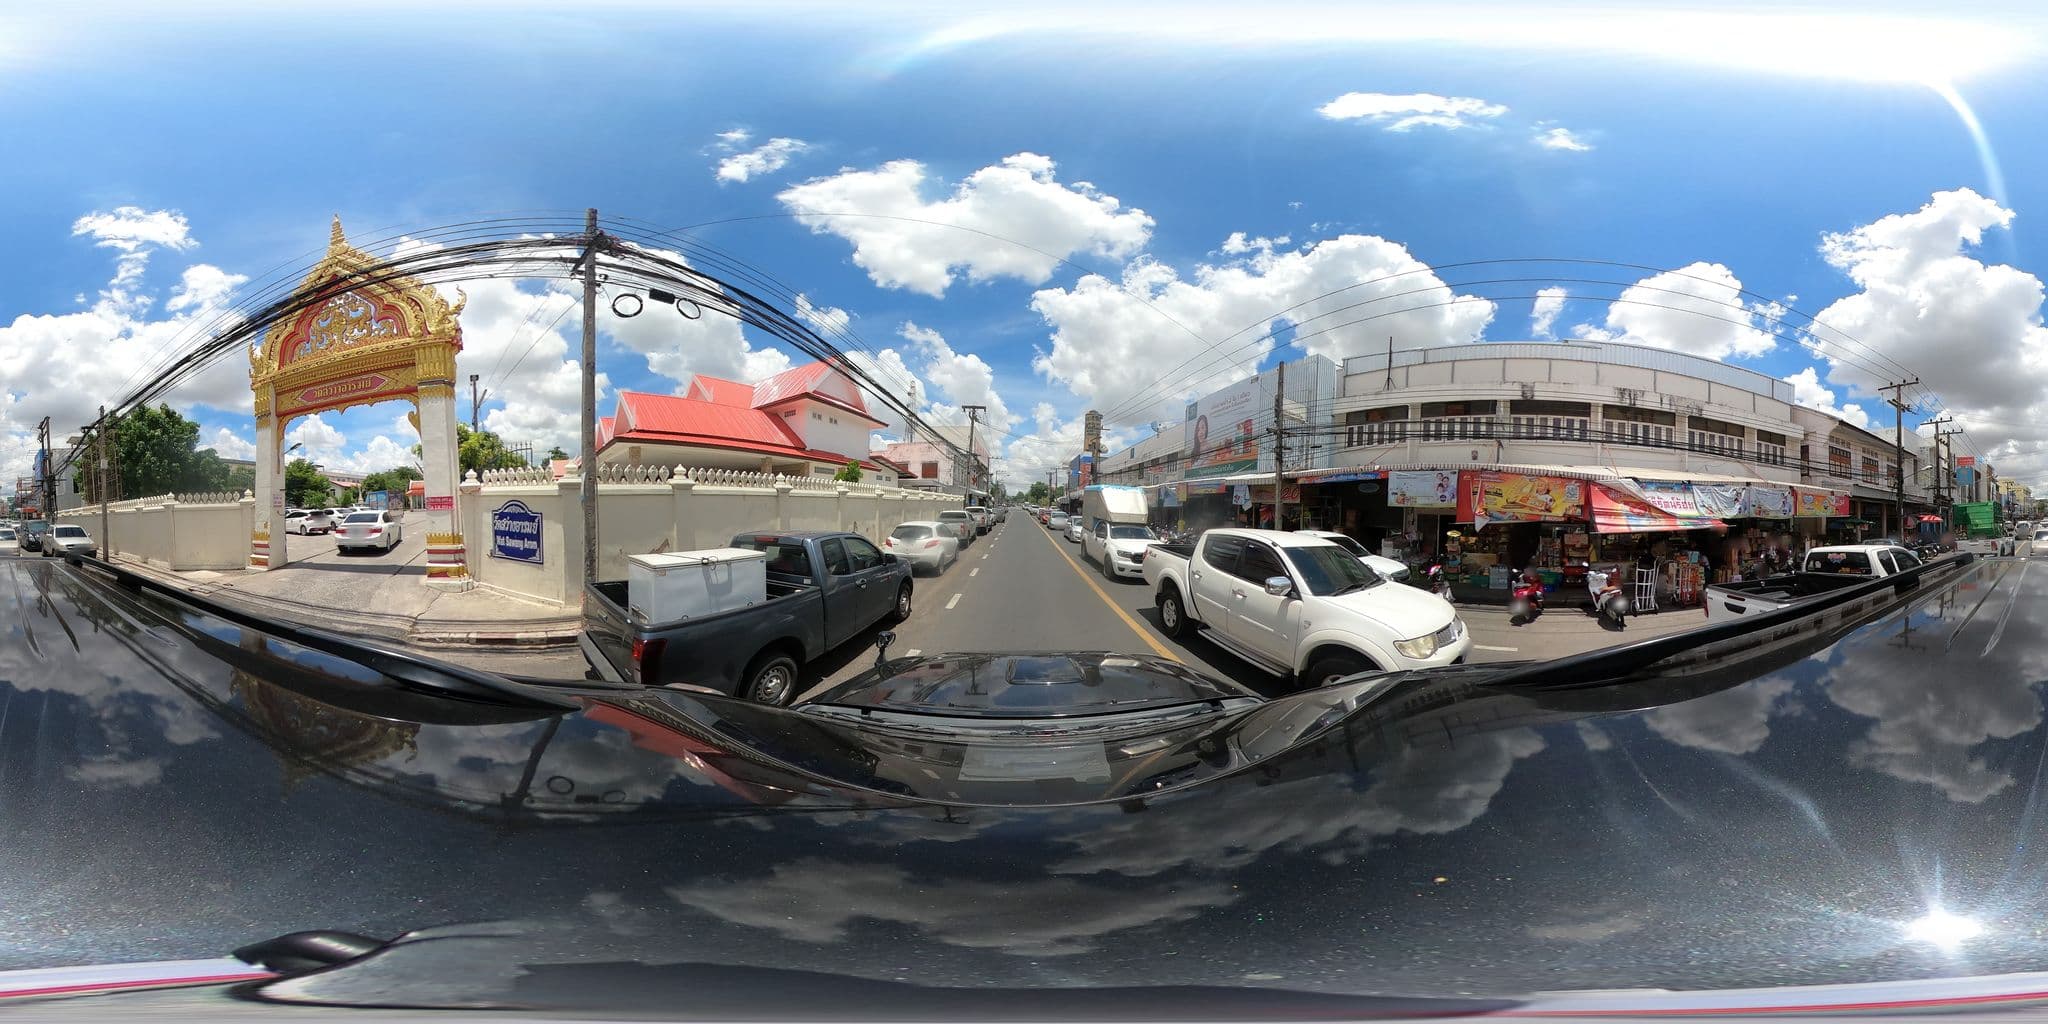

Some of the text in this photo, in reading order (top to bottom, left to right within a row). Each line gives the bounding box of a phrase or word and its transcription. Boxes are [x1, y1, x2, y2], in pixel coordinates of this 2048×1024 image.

[494, 515, 538, 534] วัดสว่างอารมณ์
[496, 535, 537, 550] Wat Sawang Arom
